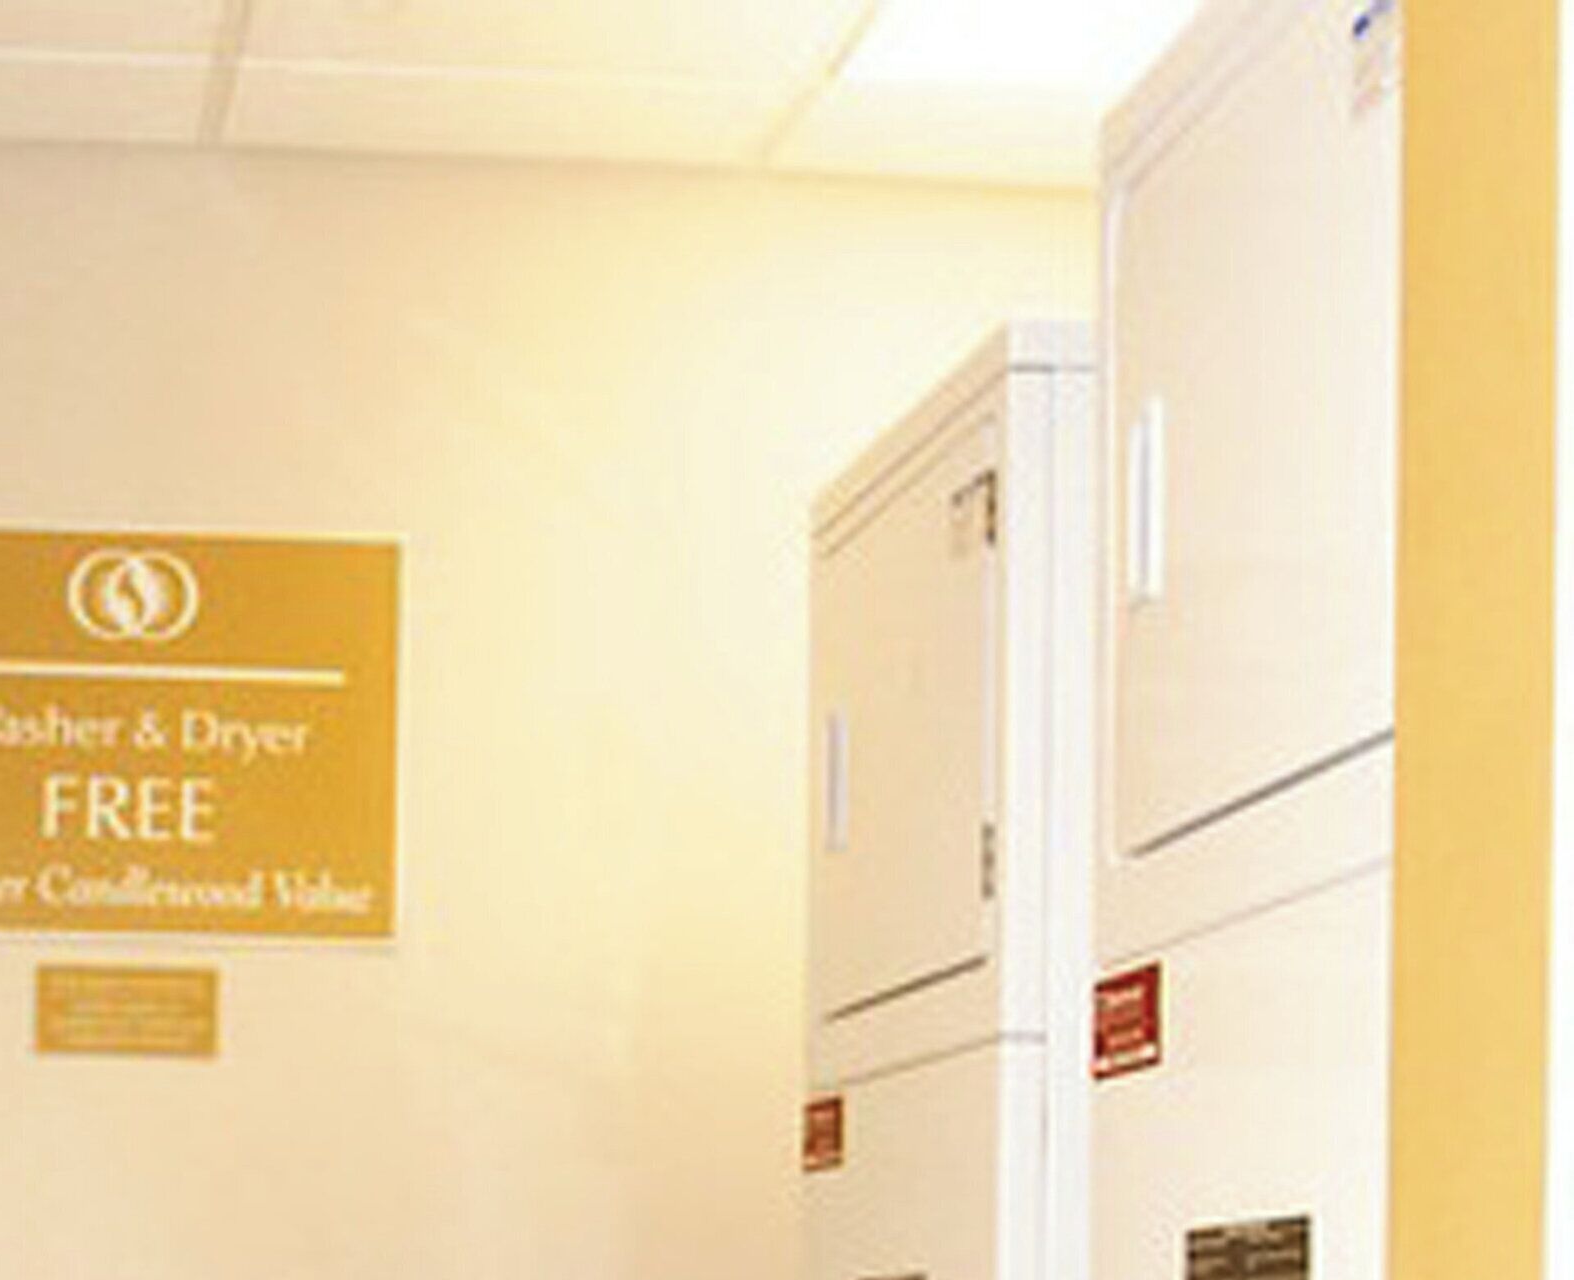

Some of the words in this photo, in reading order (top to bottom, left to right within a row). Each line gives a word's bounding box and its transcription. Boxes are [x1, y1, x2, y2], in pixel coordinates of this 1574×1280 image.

[133, 706, 168, 748] &
[182, 708, 308, 764] Dryer
[40, 773, 216, 841] FREE
[36, 865, 263, 907] Candlewood
[276, 869, 371, 913] Value
